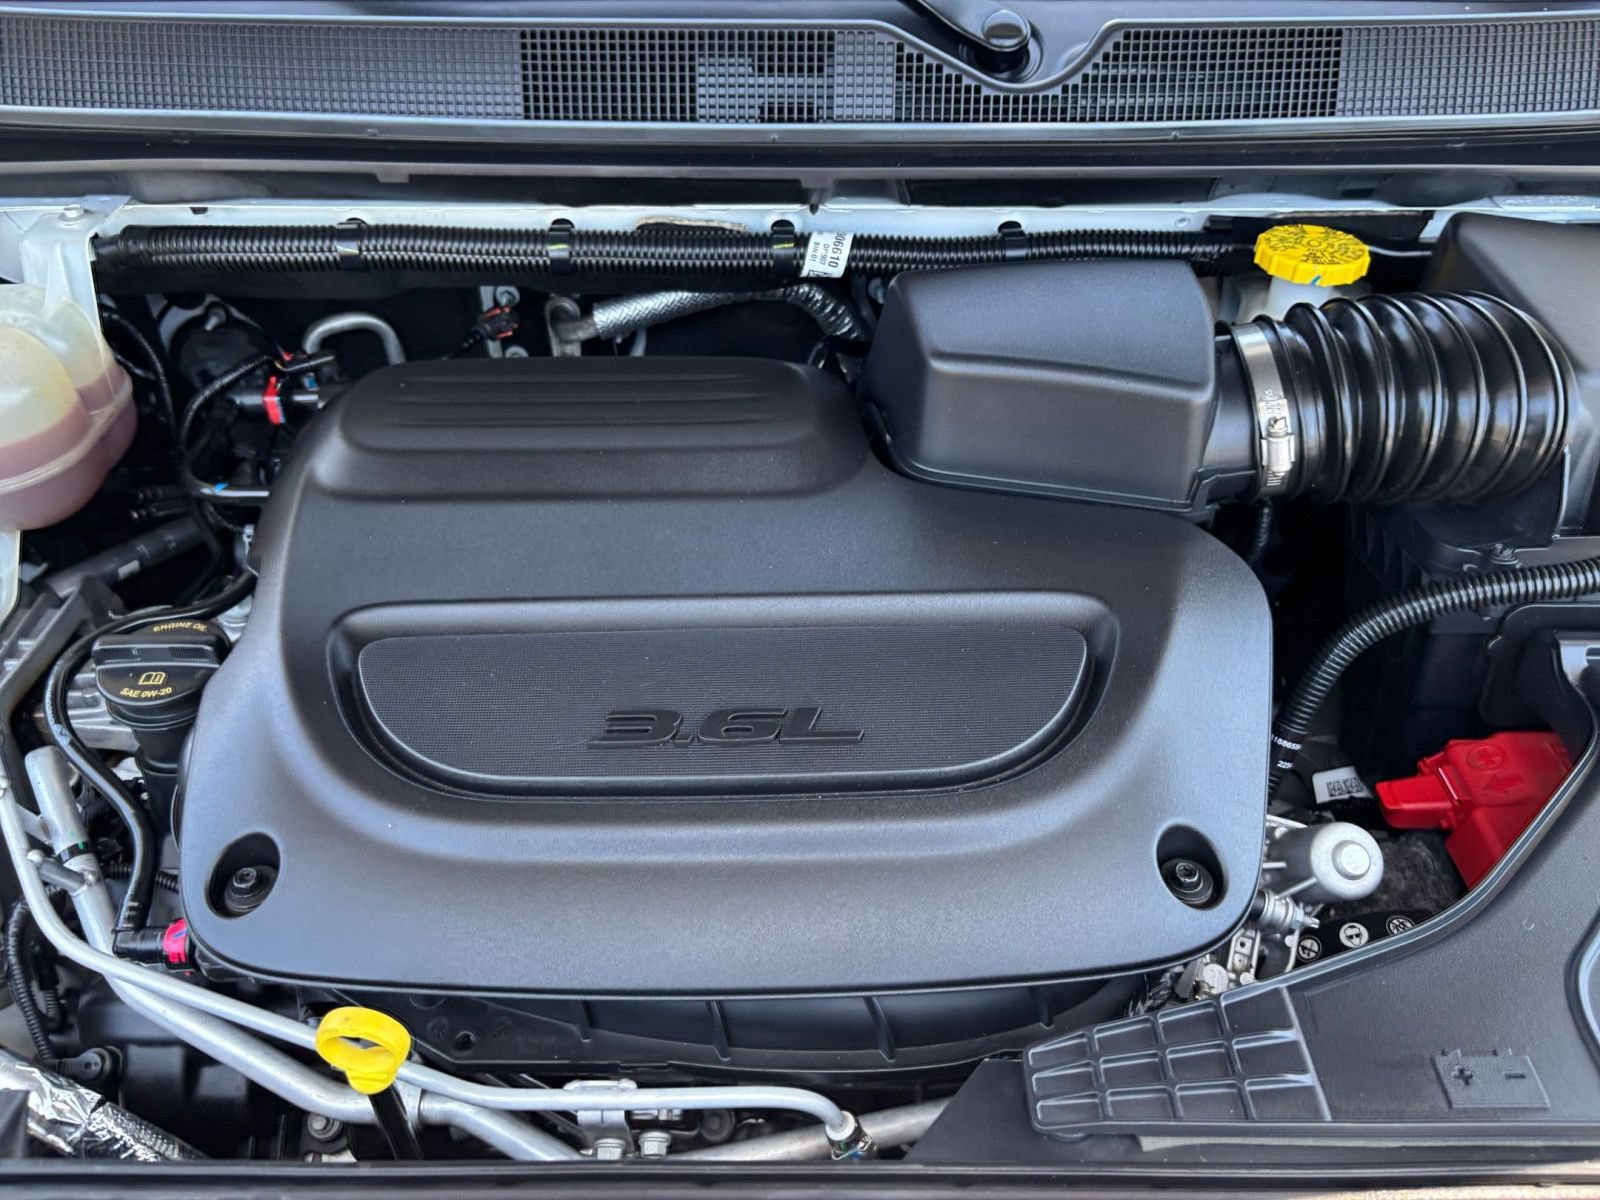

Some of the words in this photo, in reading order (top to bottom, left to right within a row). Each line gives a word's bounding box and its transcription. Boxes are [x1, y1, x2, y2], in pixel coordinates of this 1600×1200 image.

[153, 622, 192, 632] ENGINE
[120, 688, 140, 698] SAE
[141, 687, 172, 697] 0W-20
[587, 707, 864, 749] 3.6L
